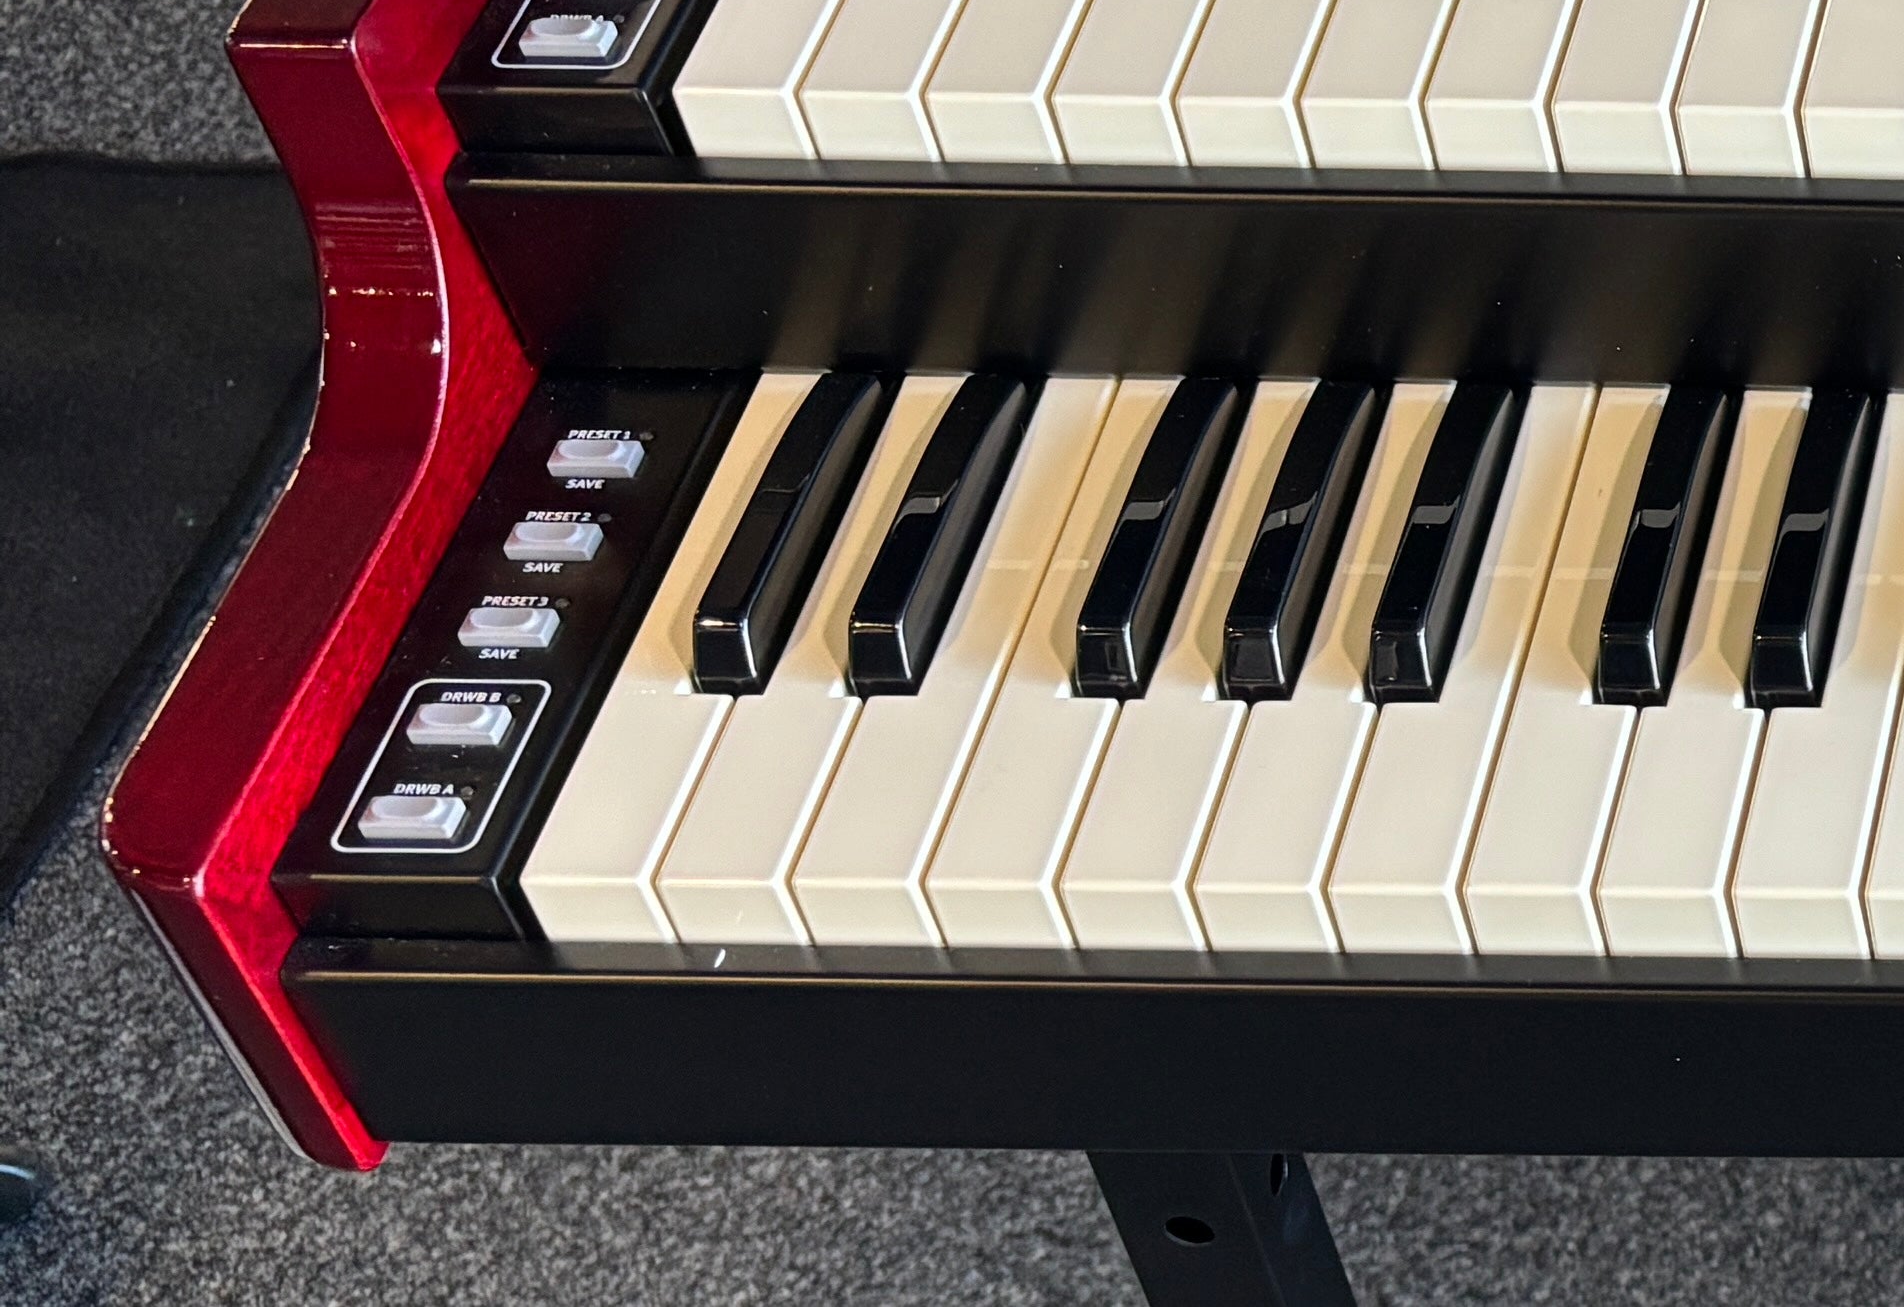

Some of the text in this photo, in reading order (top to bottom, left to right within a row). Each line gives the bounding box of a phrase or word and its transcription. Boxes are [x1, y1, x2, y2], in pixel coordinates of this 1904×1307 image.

[568, 429, 631, 440] PRESET 1
[565, 480, 604, 490] SAVE
[525, 511, 591, 522] PRESET 2
[523, 563, 563, 573] SAVE
[481, 596, 548, 607] PRESET 3
[479, 649, 520, 660] SAVE
[441, 691, 502, 703] DRWB B
[393, 783, 454, 795] DRWB A
